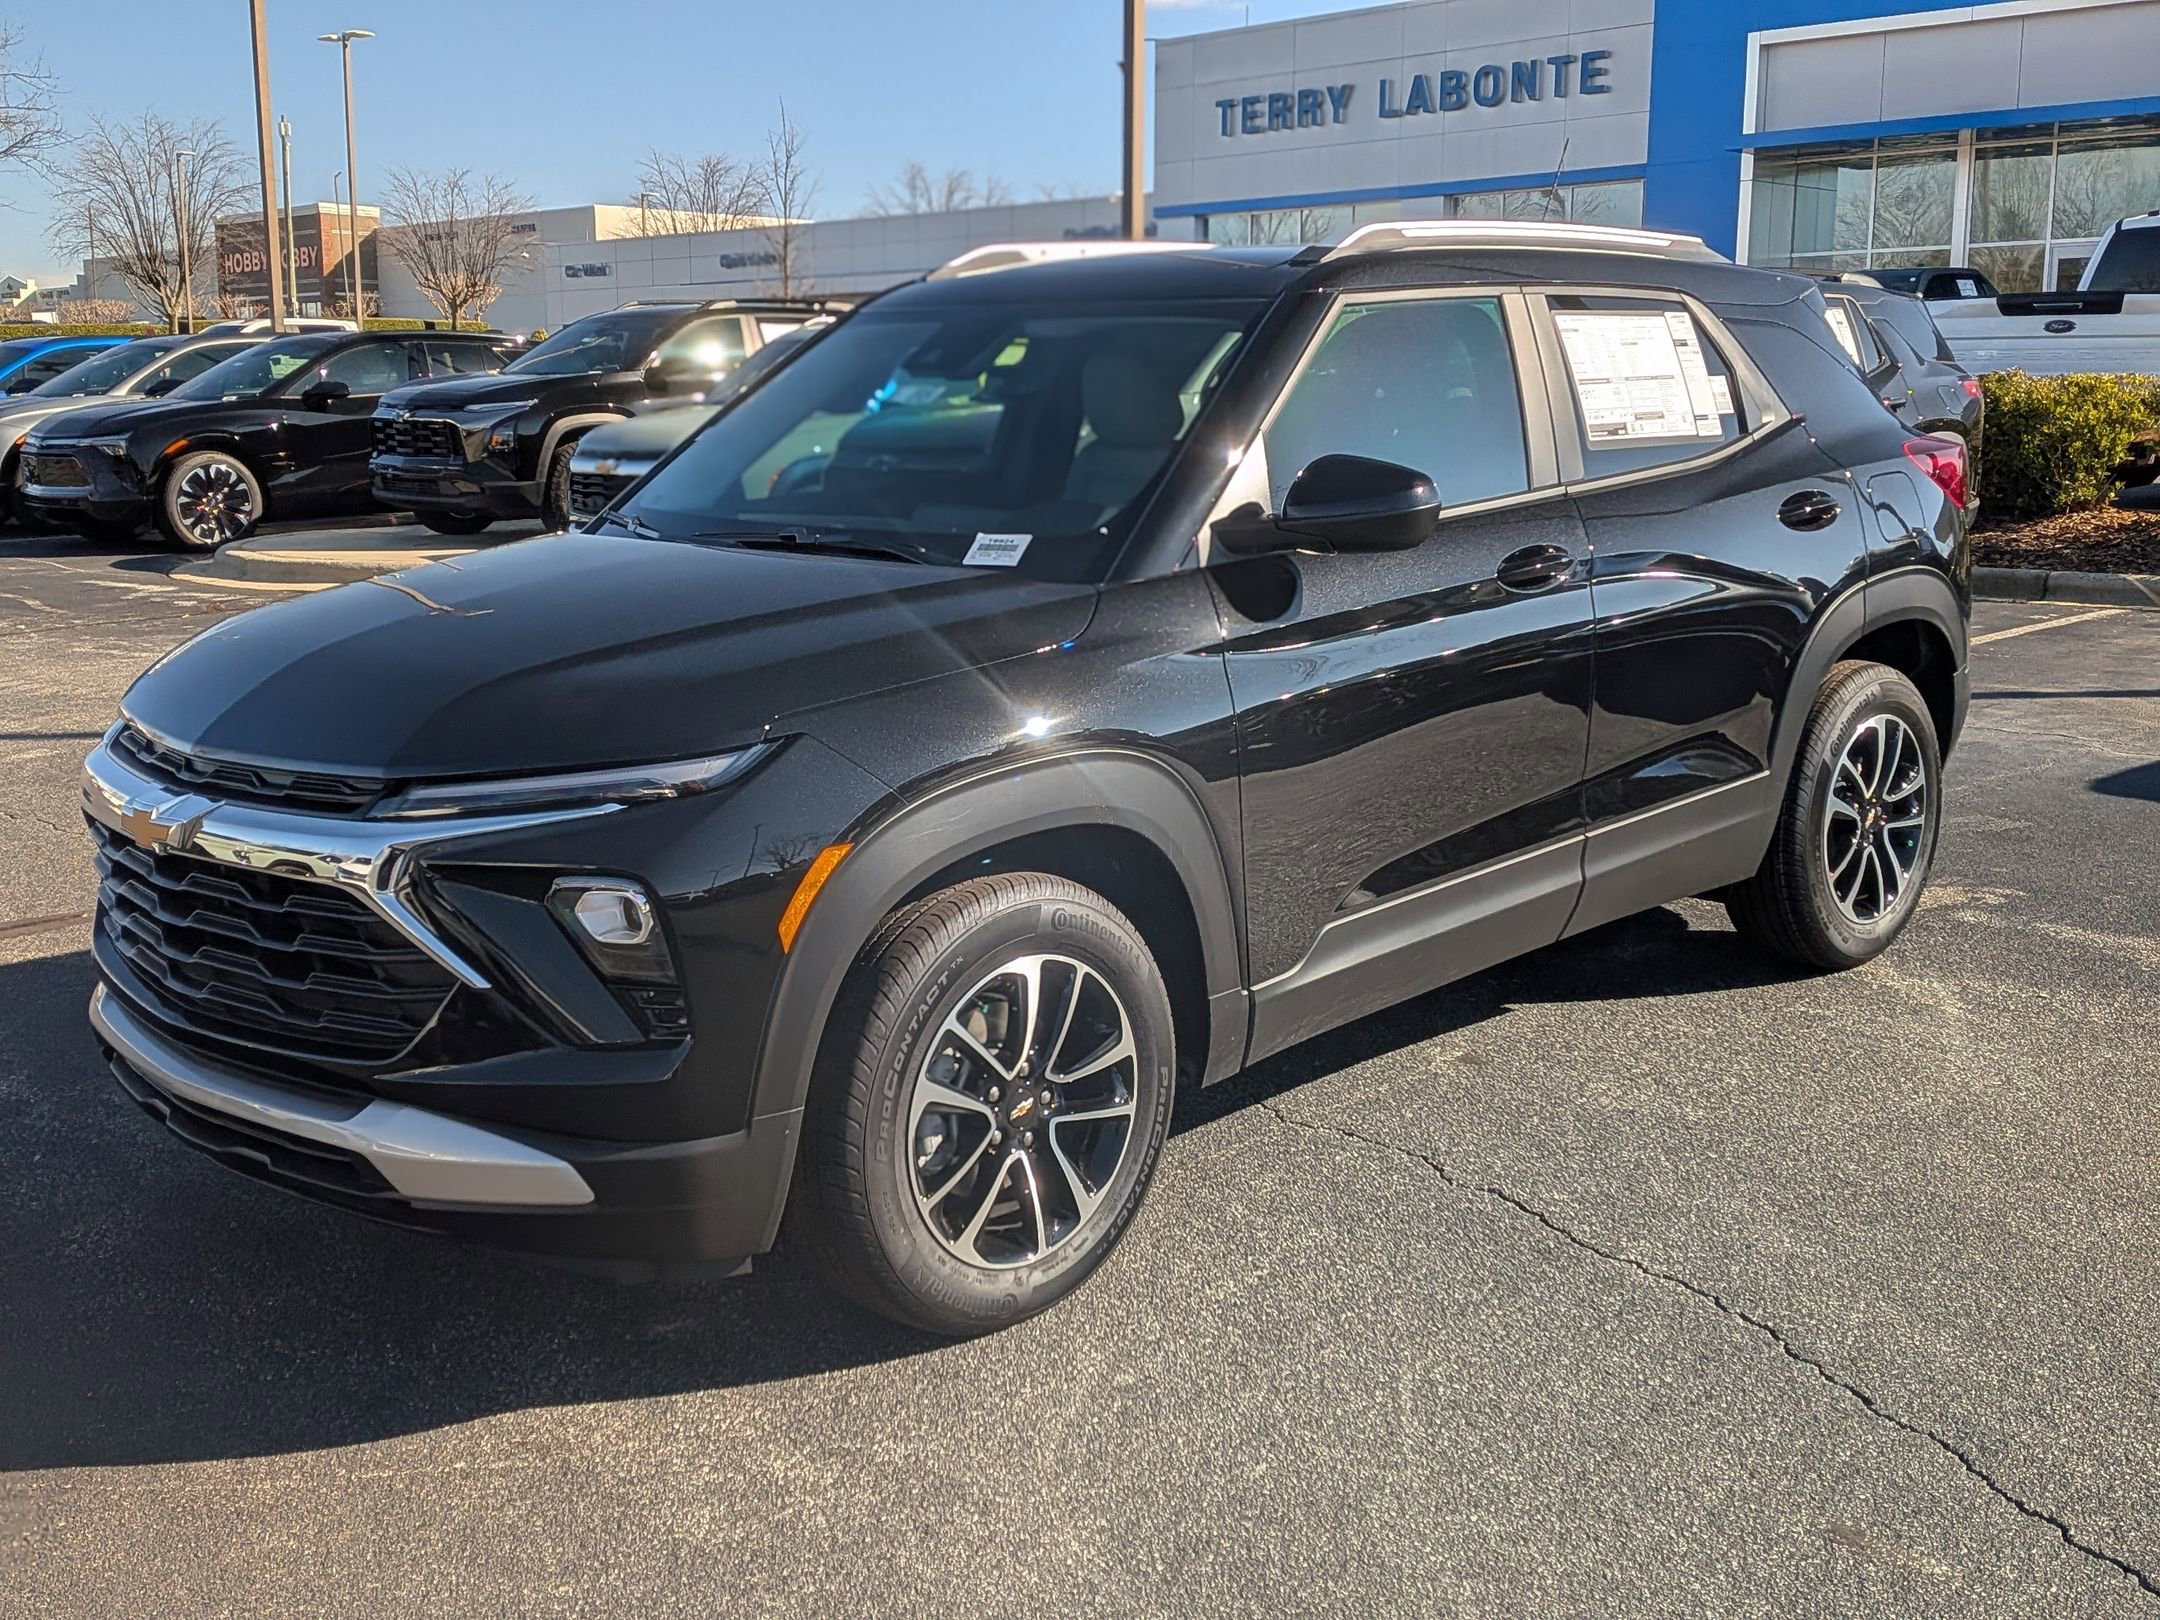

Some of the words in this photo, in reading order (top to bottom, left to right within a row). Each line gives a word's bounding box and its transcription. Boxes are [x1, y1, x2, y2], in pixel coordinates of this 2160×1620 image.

[1215, 84, 1355, 138] TERRY
[1378, 50, 1612, 120] LABONTE
[281, 246, 318, 269] OBBY
[1050, 907, 1135, 957] Continental
